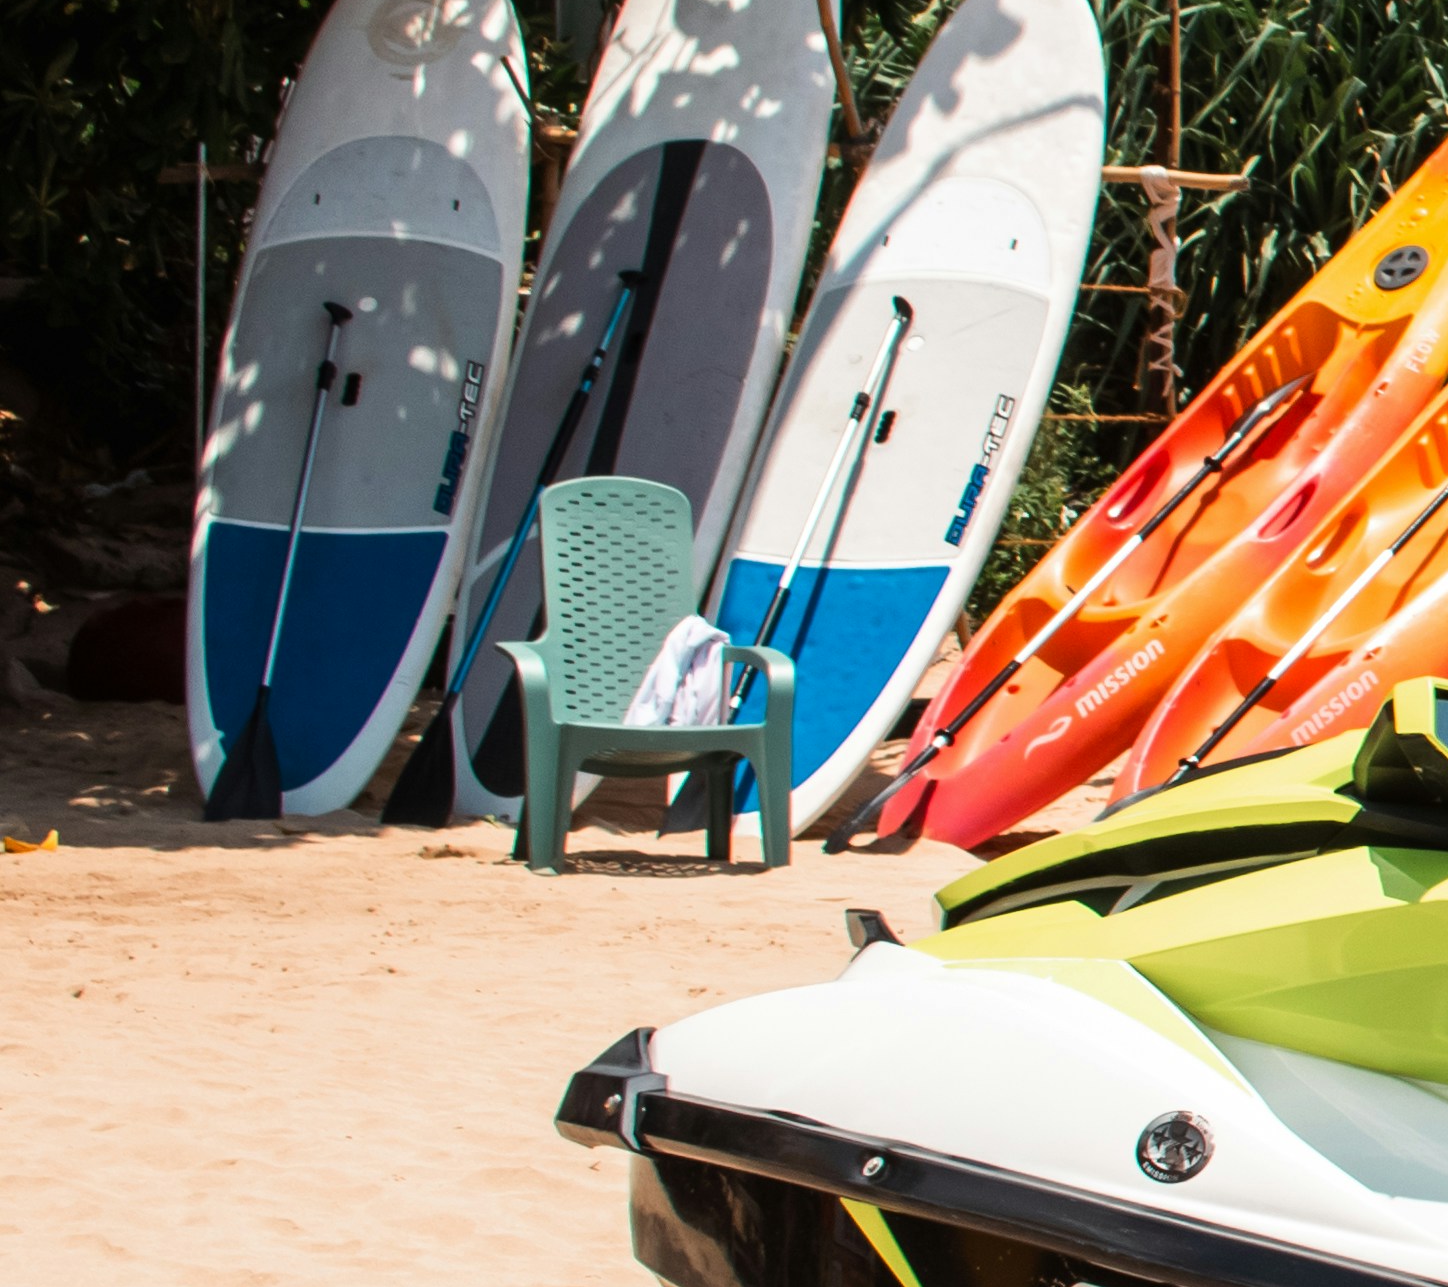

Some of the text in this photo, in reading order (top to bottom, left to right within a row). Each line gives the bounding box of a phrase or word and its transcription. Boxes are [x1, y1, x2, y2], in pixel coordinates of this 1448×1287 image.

[1404, 328, 1442, 374] FLOW
[944, 394, 1015, 546] DURA-TEC
[1075, 638, 1166, 719] mission
[1290, 668, 1380, 746] mission
